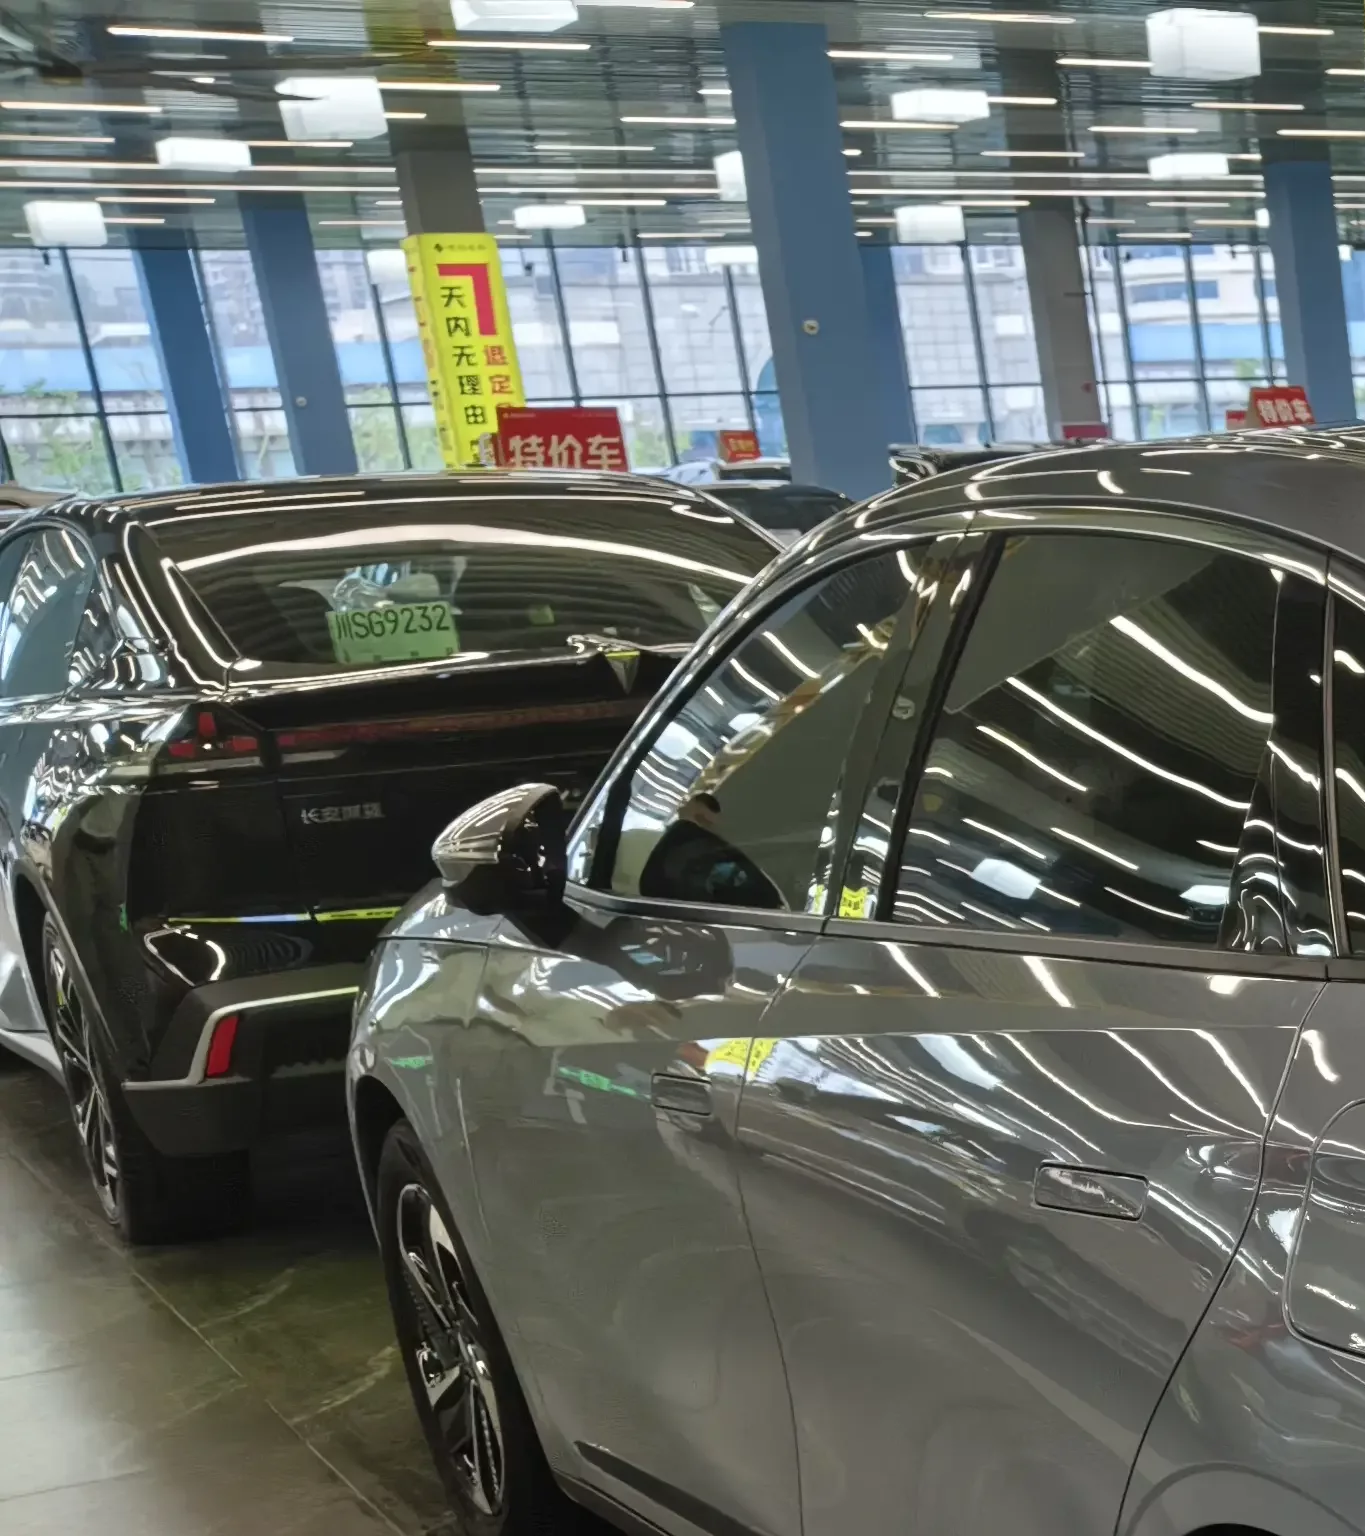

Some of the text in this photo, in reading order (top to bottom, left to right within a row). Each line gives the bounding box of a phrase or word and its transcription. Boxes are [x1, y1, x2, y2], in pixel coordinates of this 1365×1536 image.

[440, 285, 488, 425] 天内无理由
[483, 344, 515, 408] 退定
[508, 433, 623, 470] 特价车
